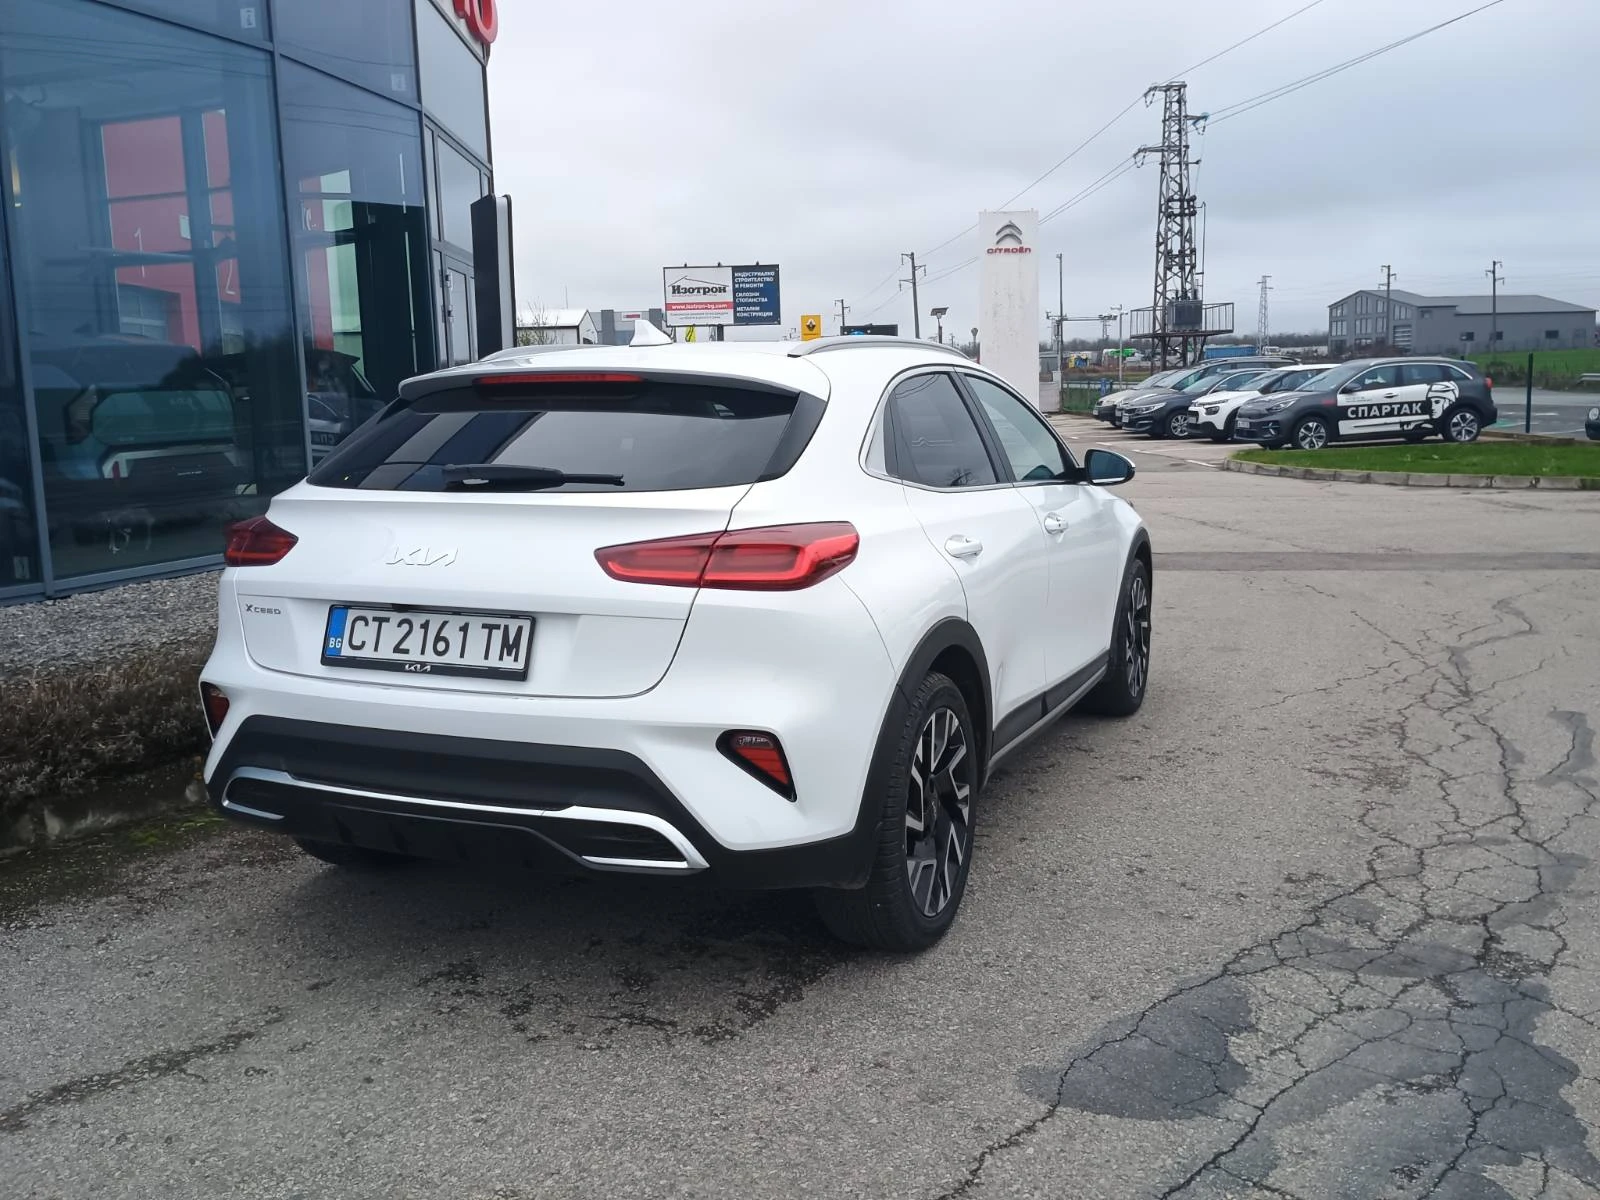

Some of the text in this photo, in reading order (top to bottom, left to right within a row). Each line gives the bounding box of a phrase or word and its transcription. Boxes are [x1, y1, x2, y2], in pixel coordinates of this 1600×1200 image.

[986, 246, 1032, 254] CITROËN
[671, 284, 727, 295] Изотрон
[1347, 402, 1422, 418] СПАРТАК
[329, 637, 342, 648] BG
